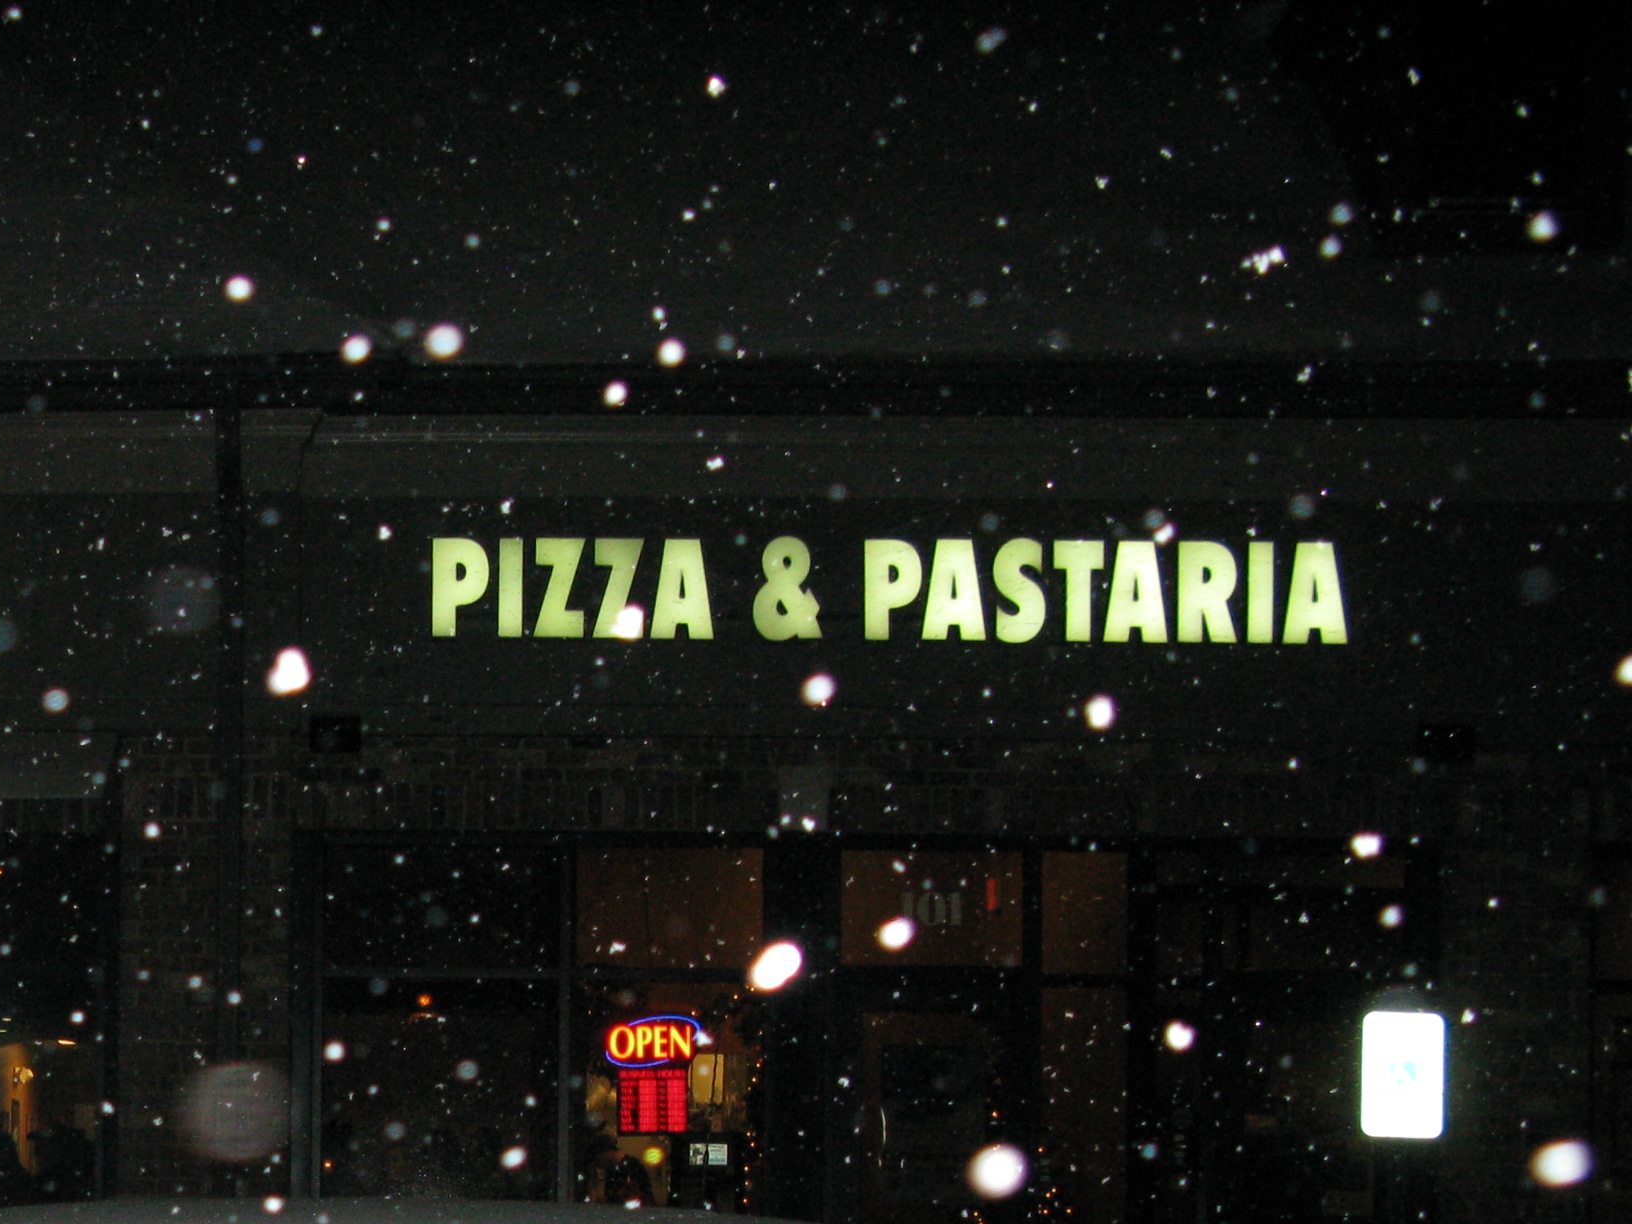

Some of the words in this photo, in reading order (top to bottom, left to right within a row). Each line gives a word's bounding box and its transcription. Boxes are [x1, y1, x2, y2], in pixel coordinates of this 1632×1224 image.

[431, 537, 714, 640] PIZZA
[752, 536, 822, 641] &
[863, 537, 1348, 645] PASTARIA
[609, 1026, 691, 1060] OPEN
